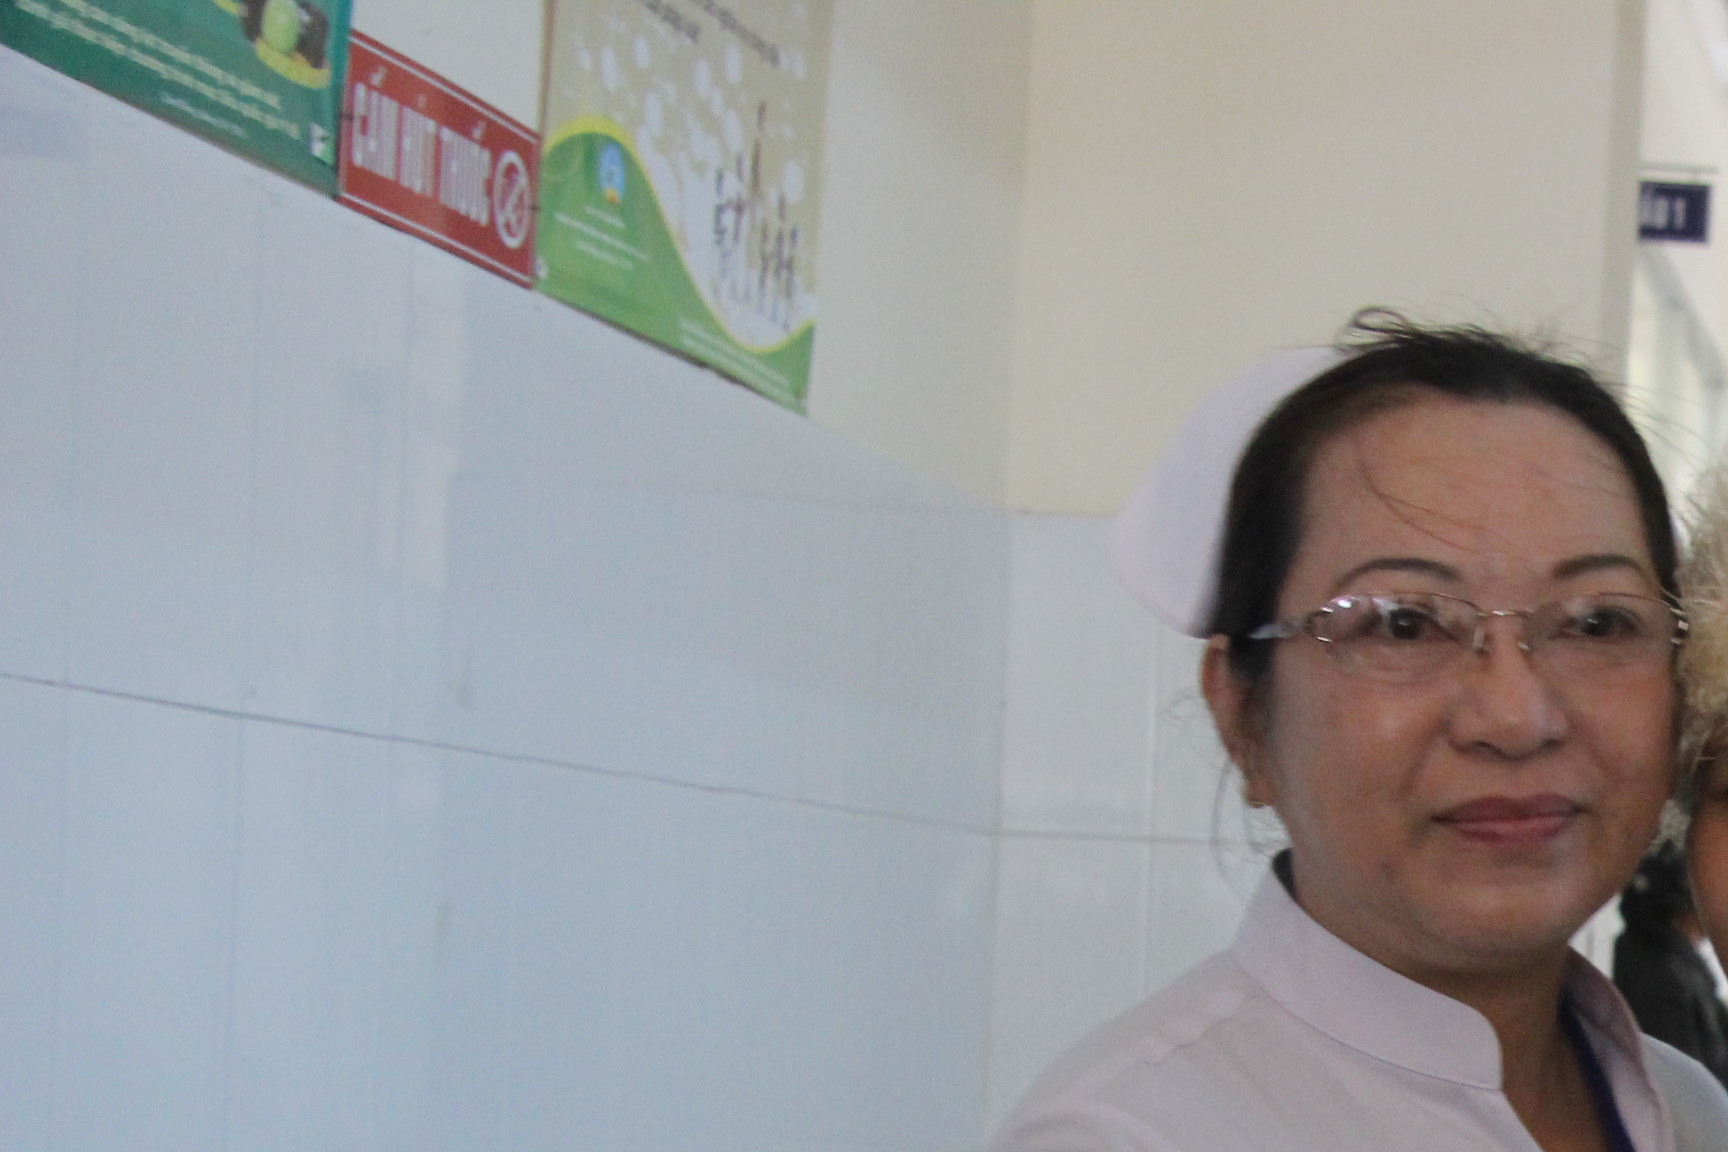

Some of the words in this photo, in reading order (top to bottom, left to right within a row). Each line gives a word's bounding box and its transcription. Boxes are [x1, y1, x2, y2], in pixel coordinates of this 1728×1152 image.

[351, 65, 399, 181] CẤM
[399, 94, 437, 198] HÚT
[438, 120, 492, 228] THUỐC
